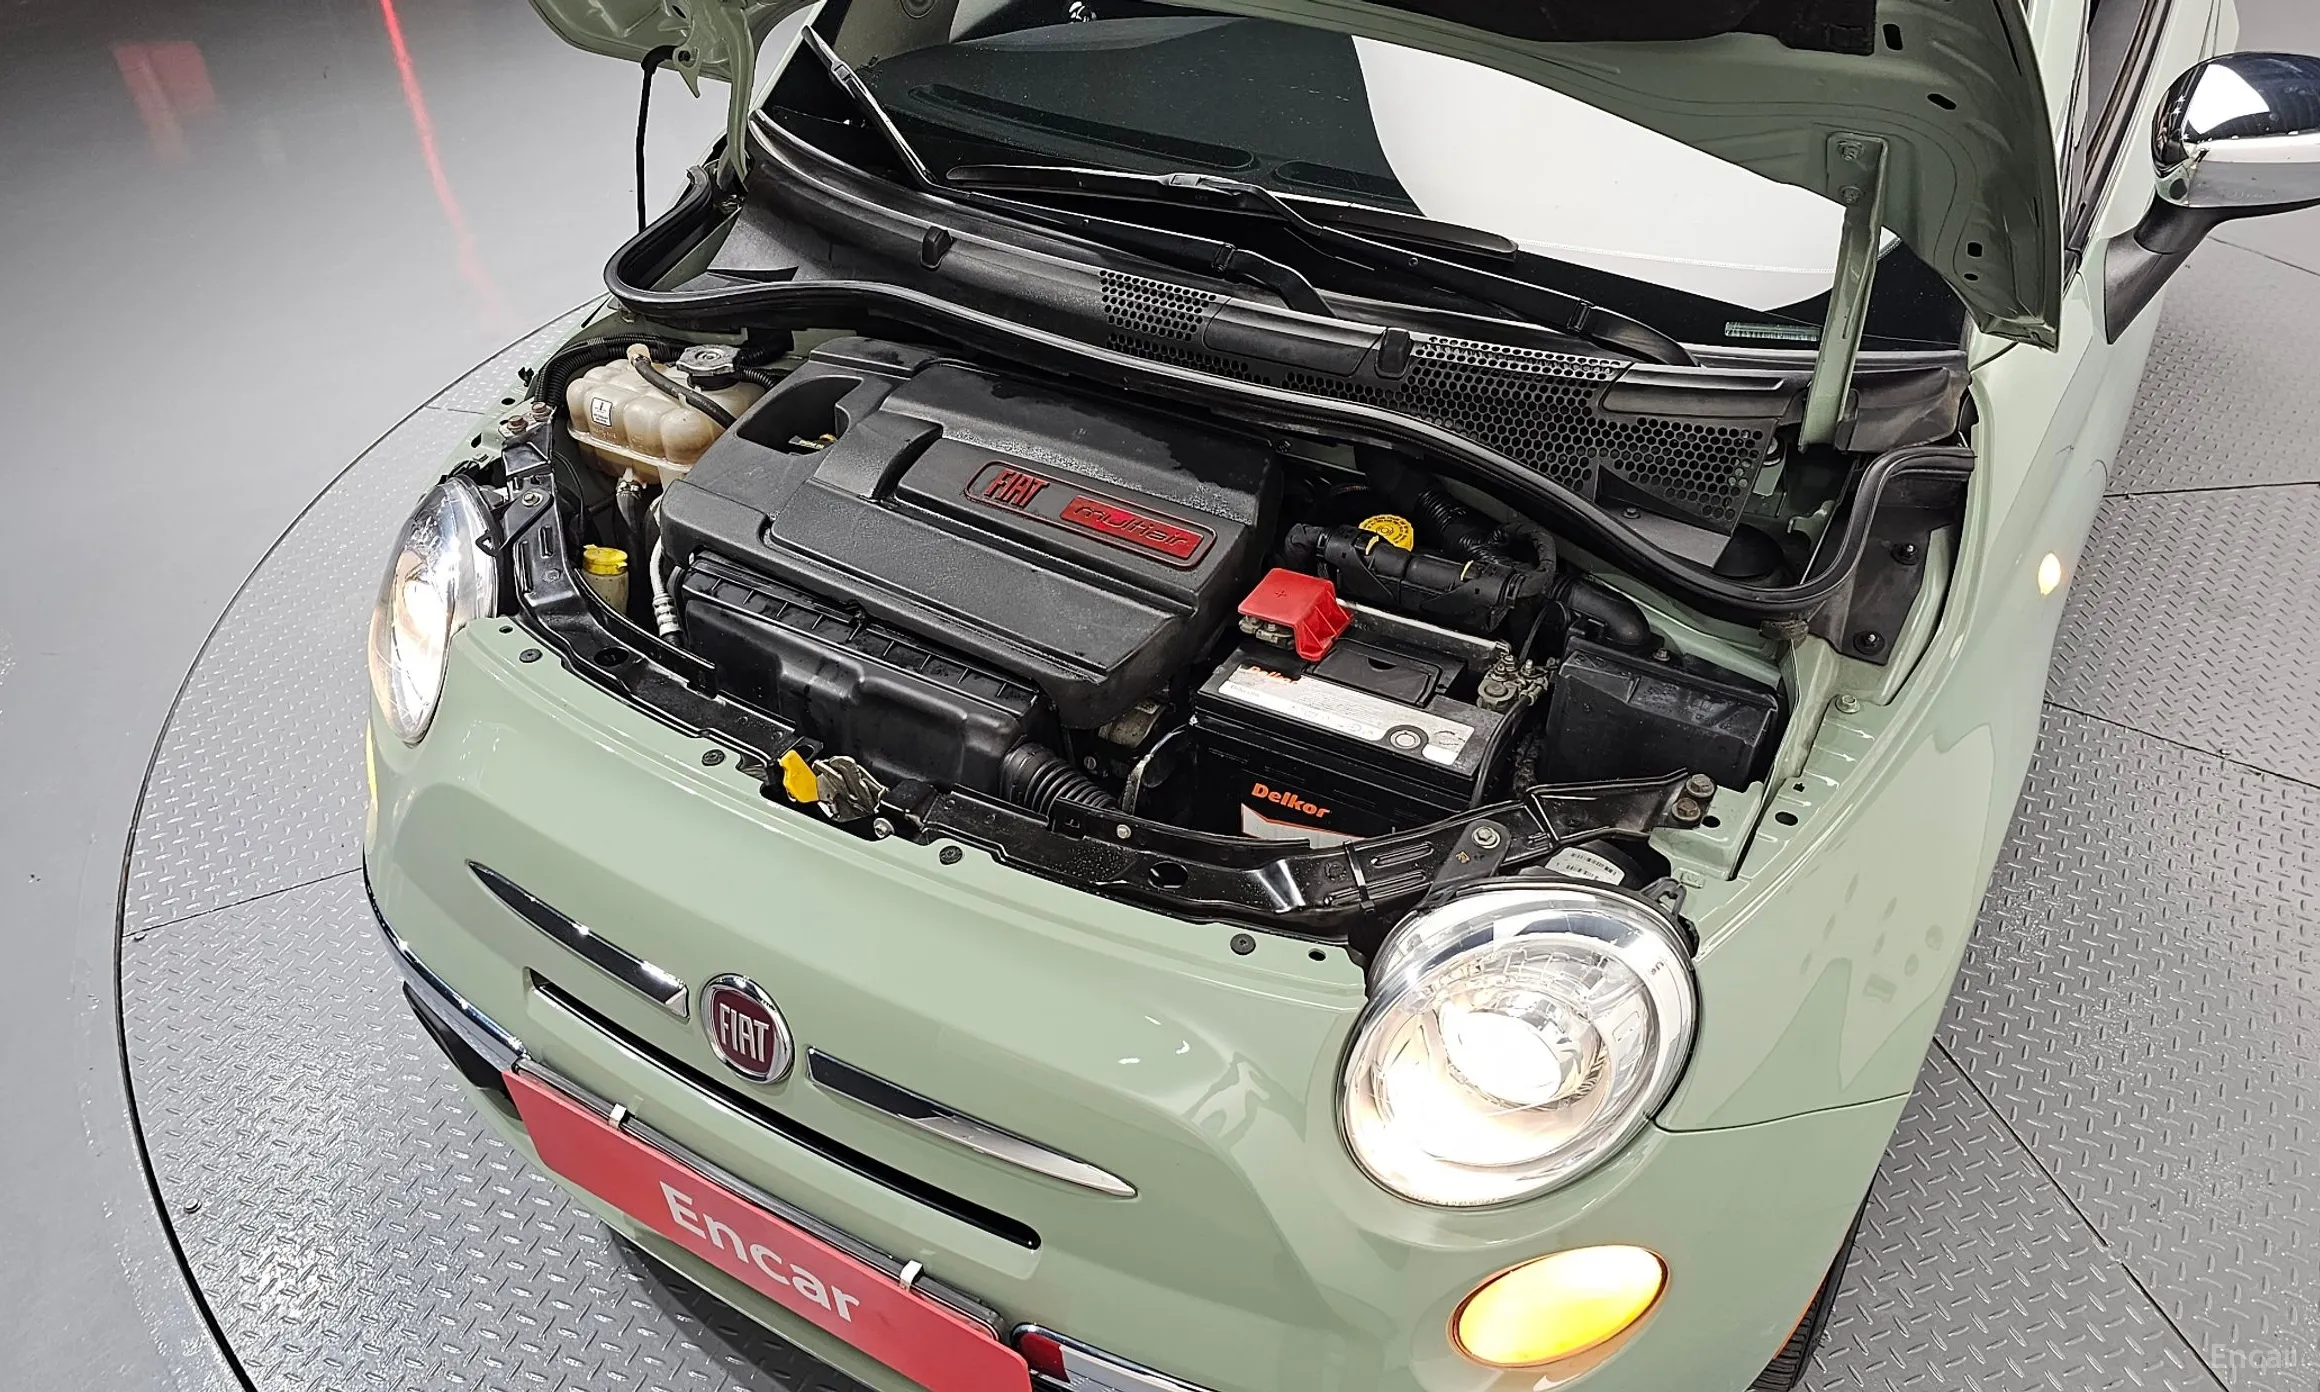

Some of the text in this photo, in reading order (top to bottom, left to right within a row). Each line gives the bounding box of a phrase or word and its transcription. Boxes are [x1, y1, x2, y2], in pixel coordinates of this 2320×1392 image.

[984, 467, 1050, 509] FIAT
[1251, 782, 1331, 818] Delkor
[719, 1003, 770, 1063] FIAT
[660, 1181, 860, 1321] Encar
